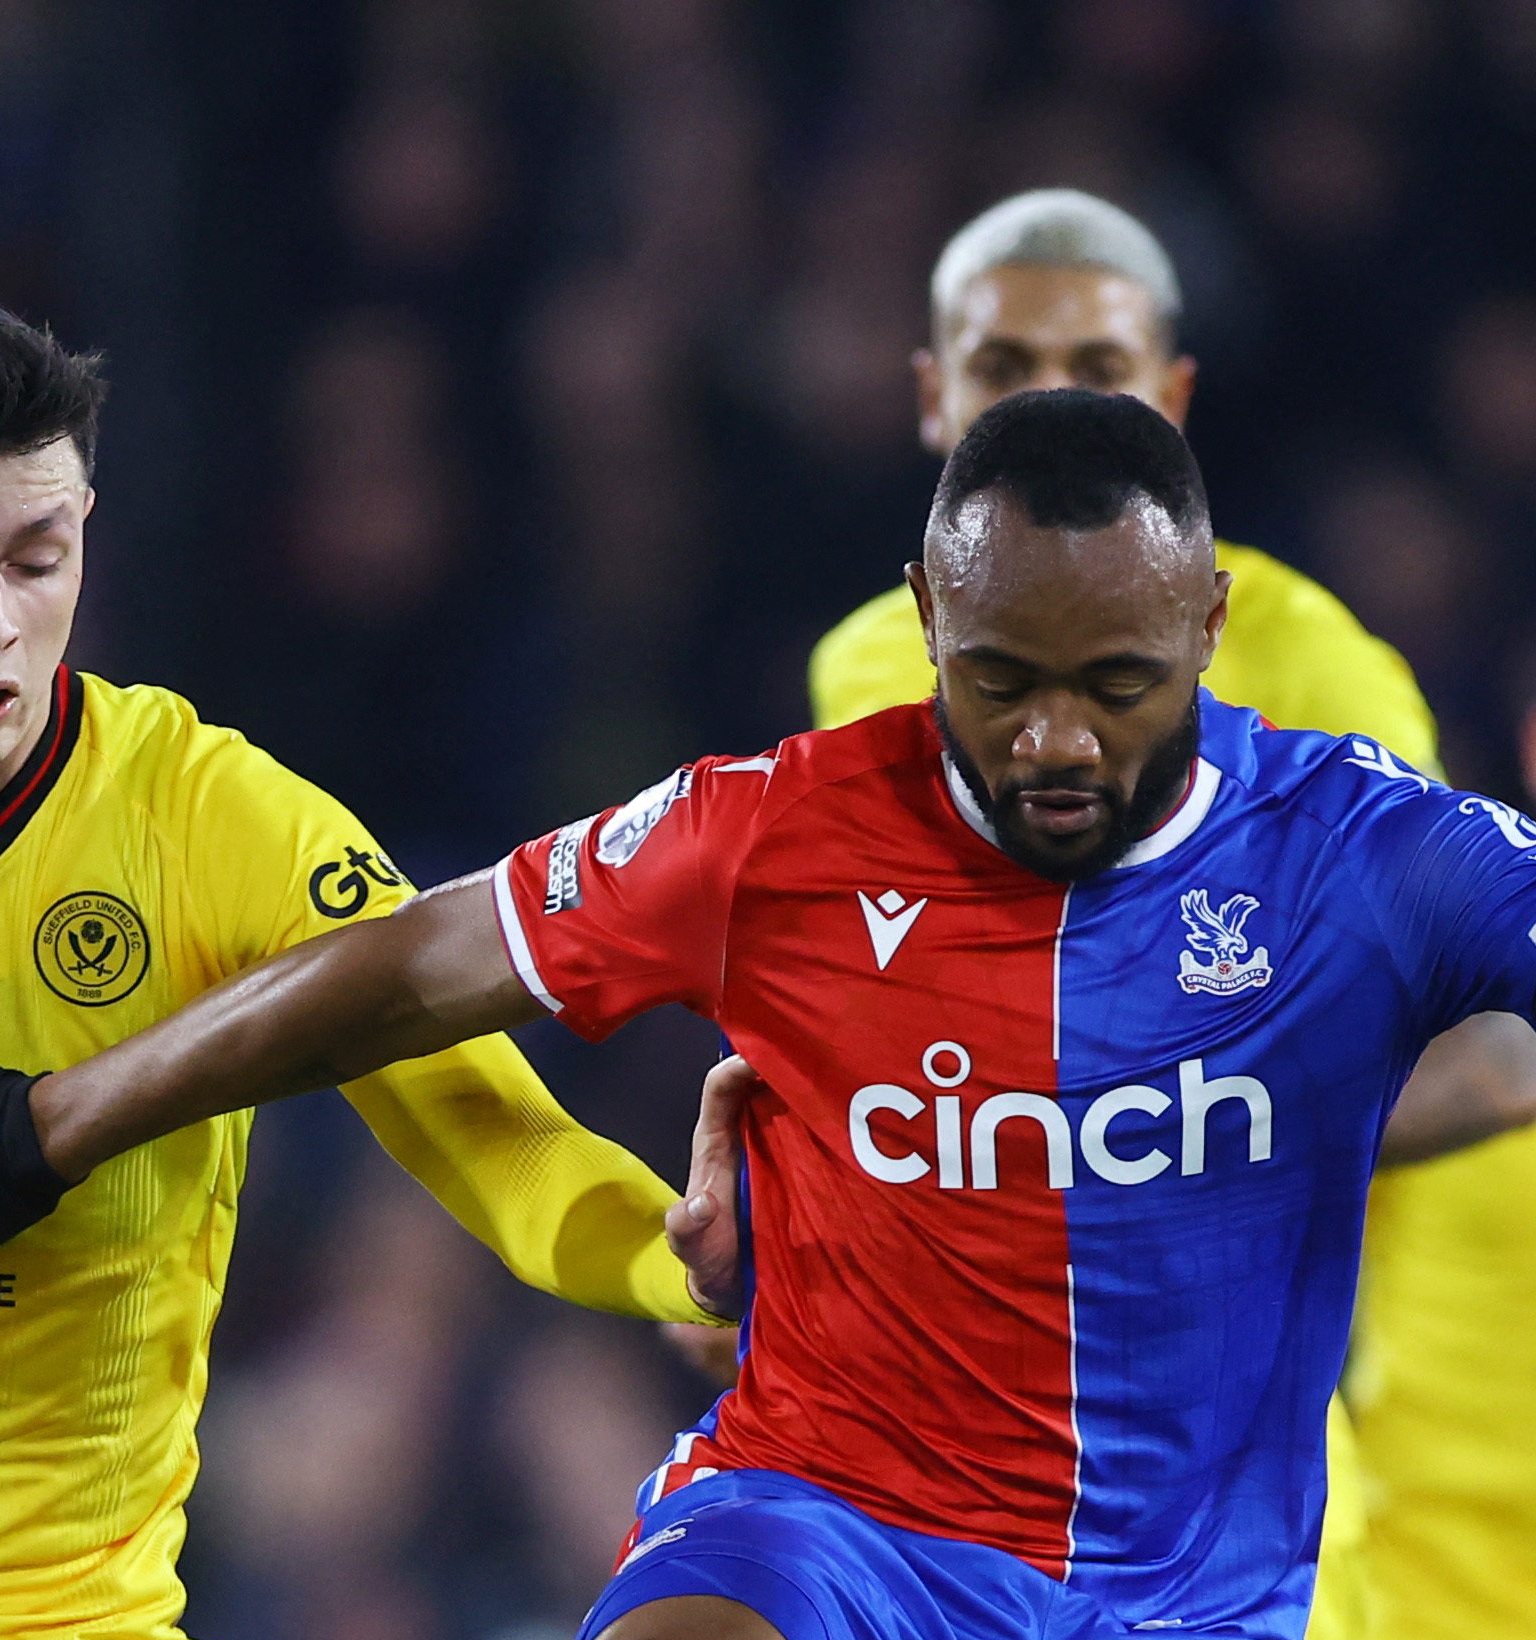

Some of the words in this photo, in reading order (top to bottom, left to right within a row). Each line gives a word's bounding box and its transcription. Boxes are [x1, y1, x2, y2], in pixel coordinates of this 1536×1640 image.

[43, 899, 92, 945] SHEFFIELD
[96, 900, 134, 929] UNITED
[129, 931, 141, 953] F.C.
[1186, 976, 1221, 990] CRYSTAL
[1221, 972, 1251, 990] PALACE
[849, 1040, 1272, 1190] cinch
